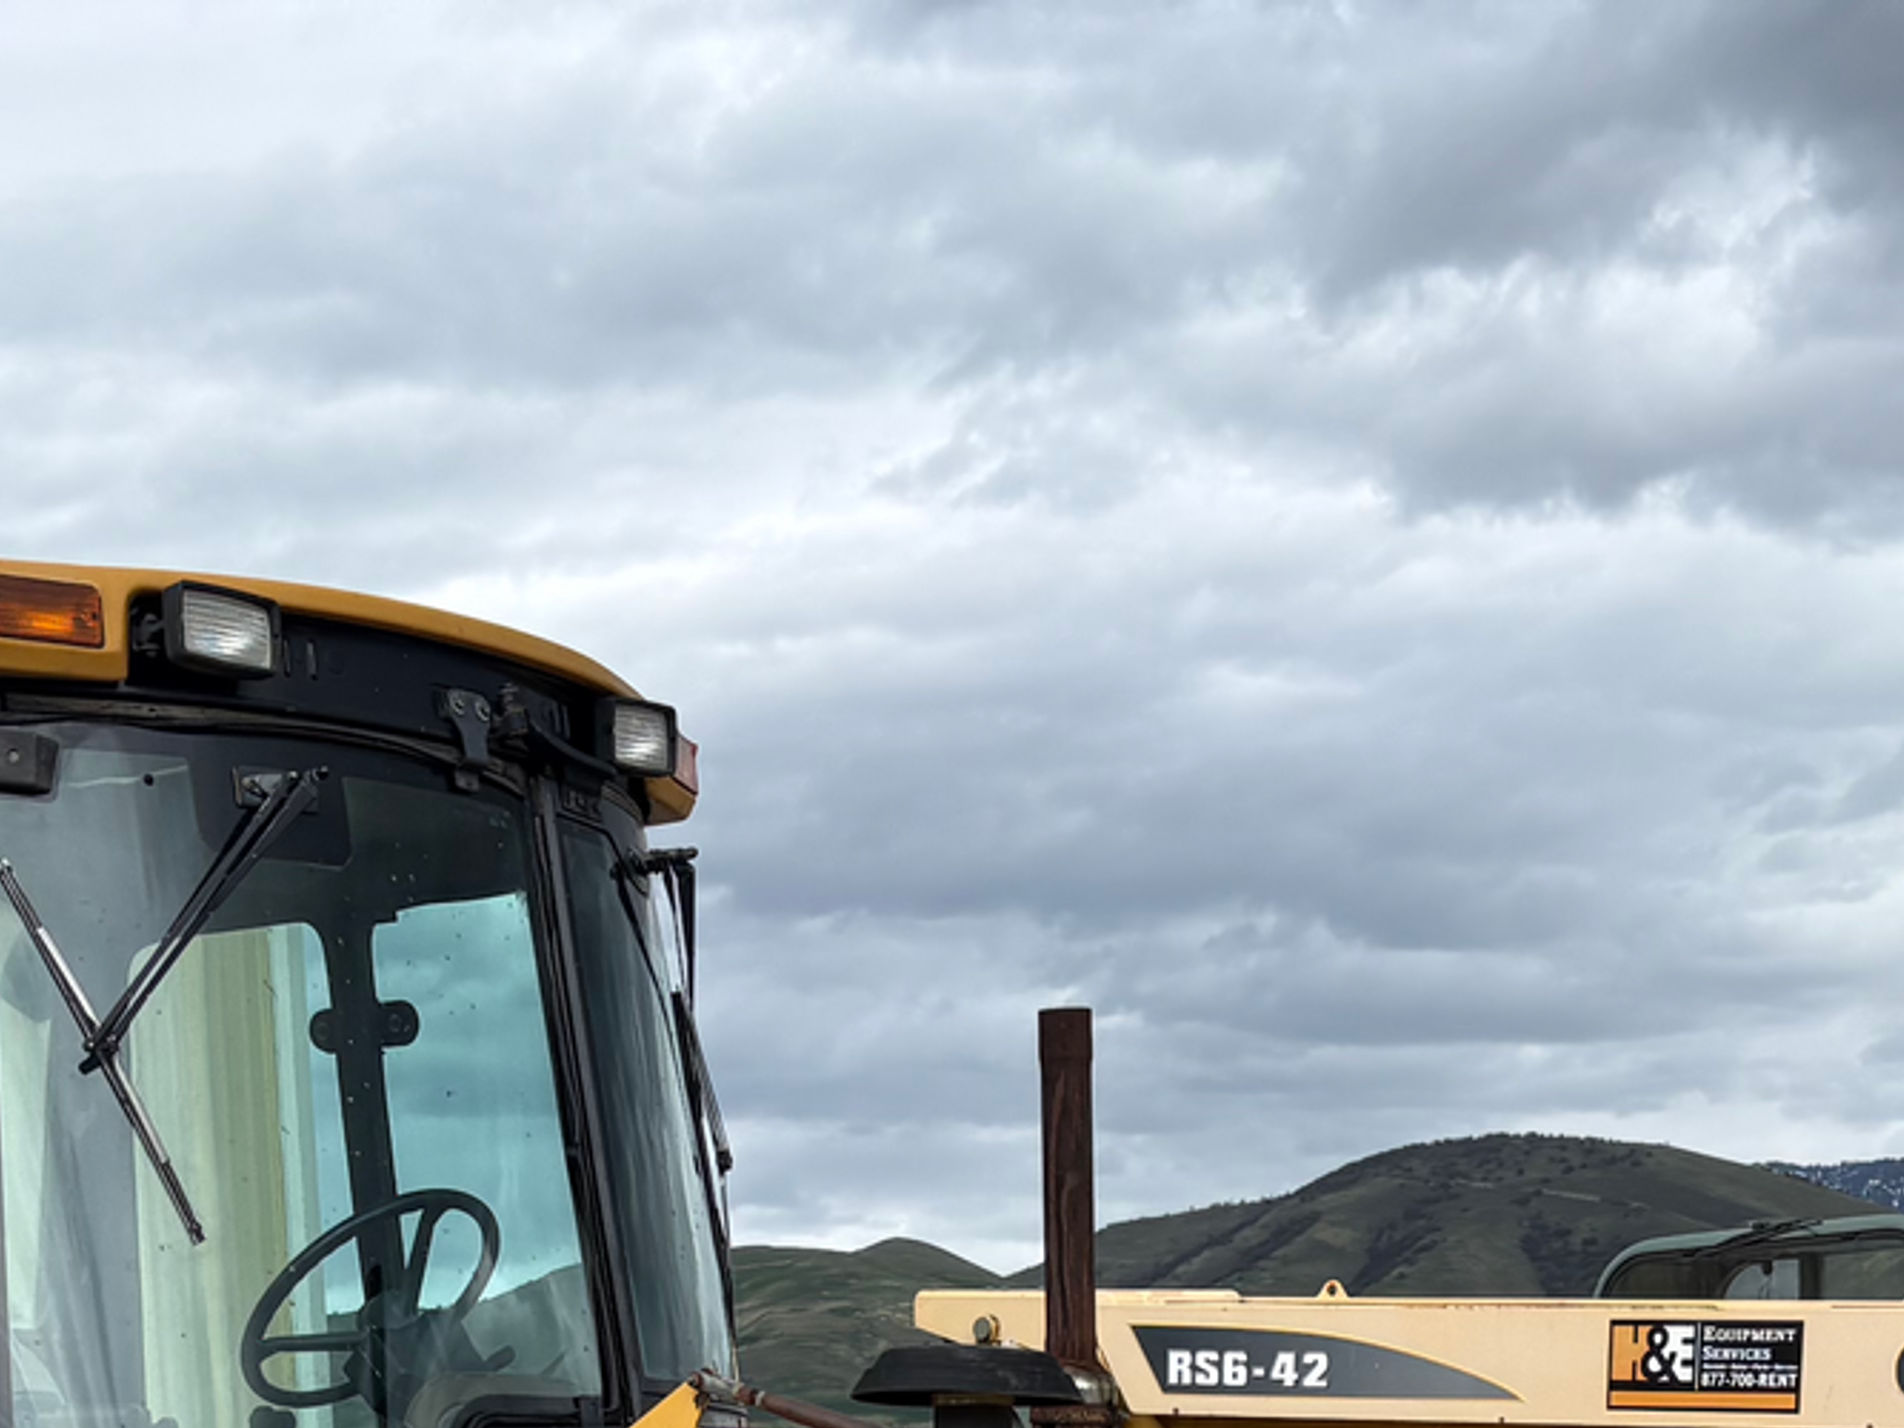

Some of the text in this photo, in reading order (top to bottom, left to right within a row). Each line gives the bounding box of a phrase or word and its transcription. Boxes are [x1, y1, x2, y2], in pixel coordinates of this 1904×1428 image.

[1703, 1325, 1796, 1341] EQUIPMENT
[1610, 1324, 1696, 1382] H&E
[1702, 1345, 1772, 1361] SERVICES
[1166, 1349, 1329, 1388] RS6-42
[1700, 1371, 1798, 1387] 877-700-RENT
